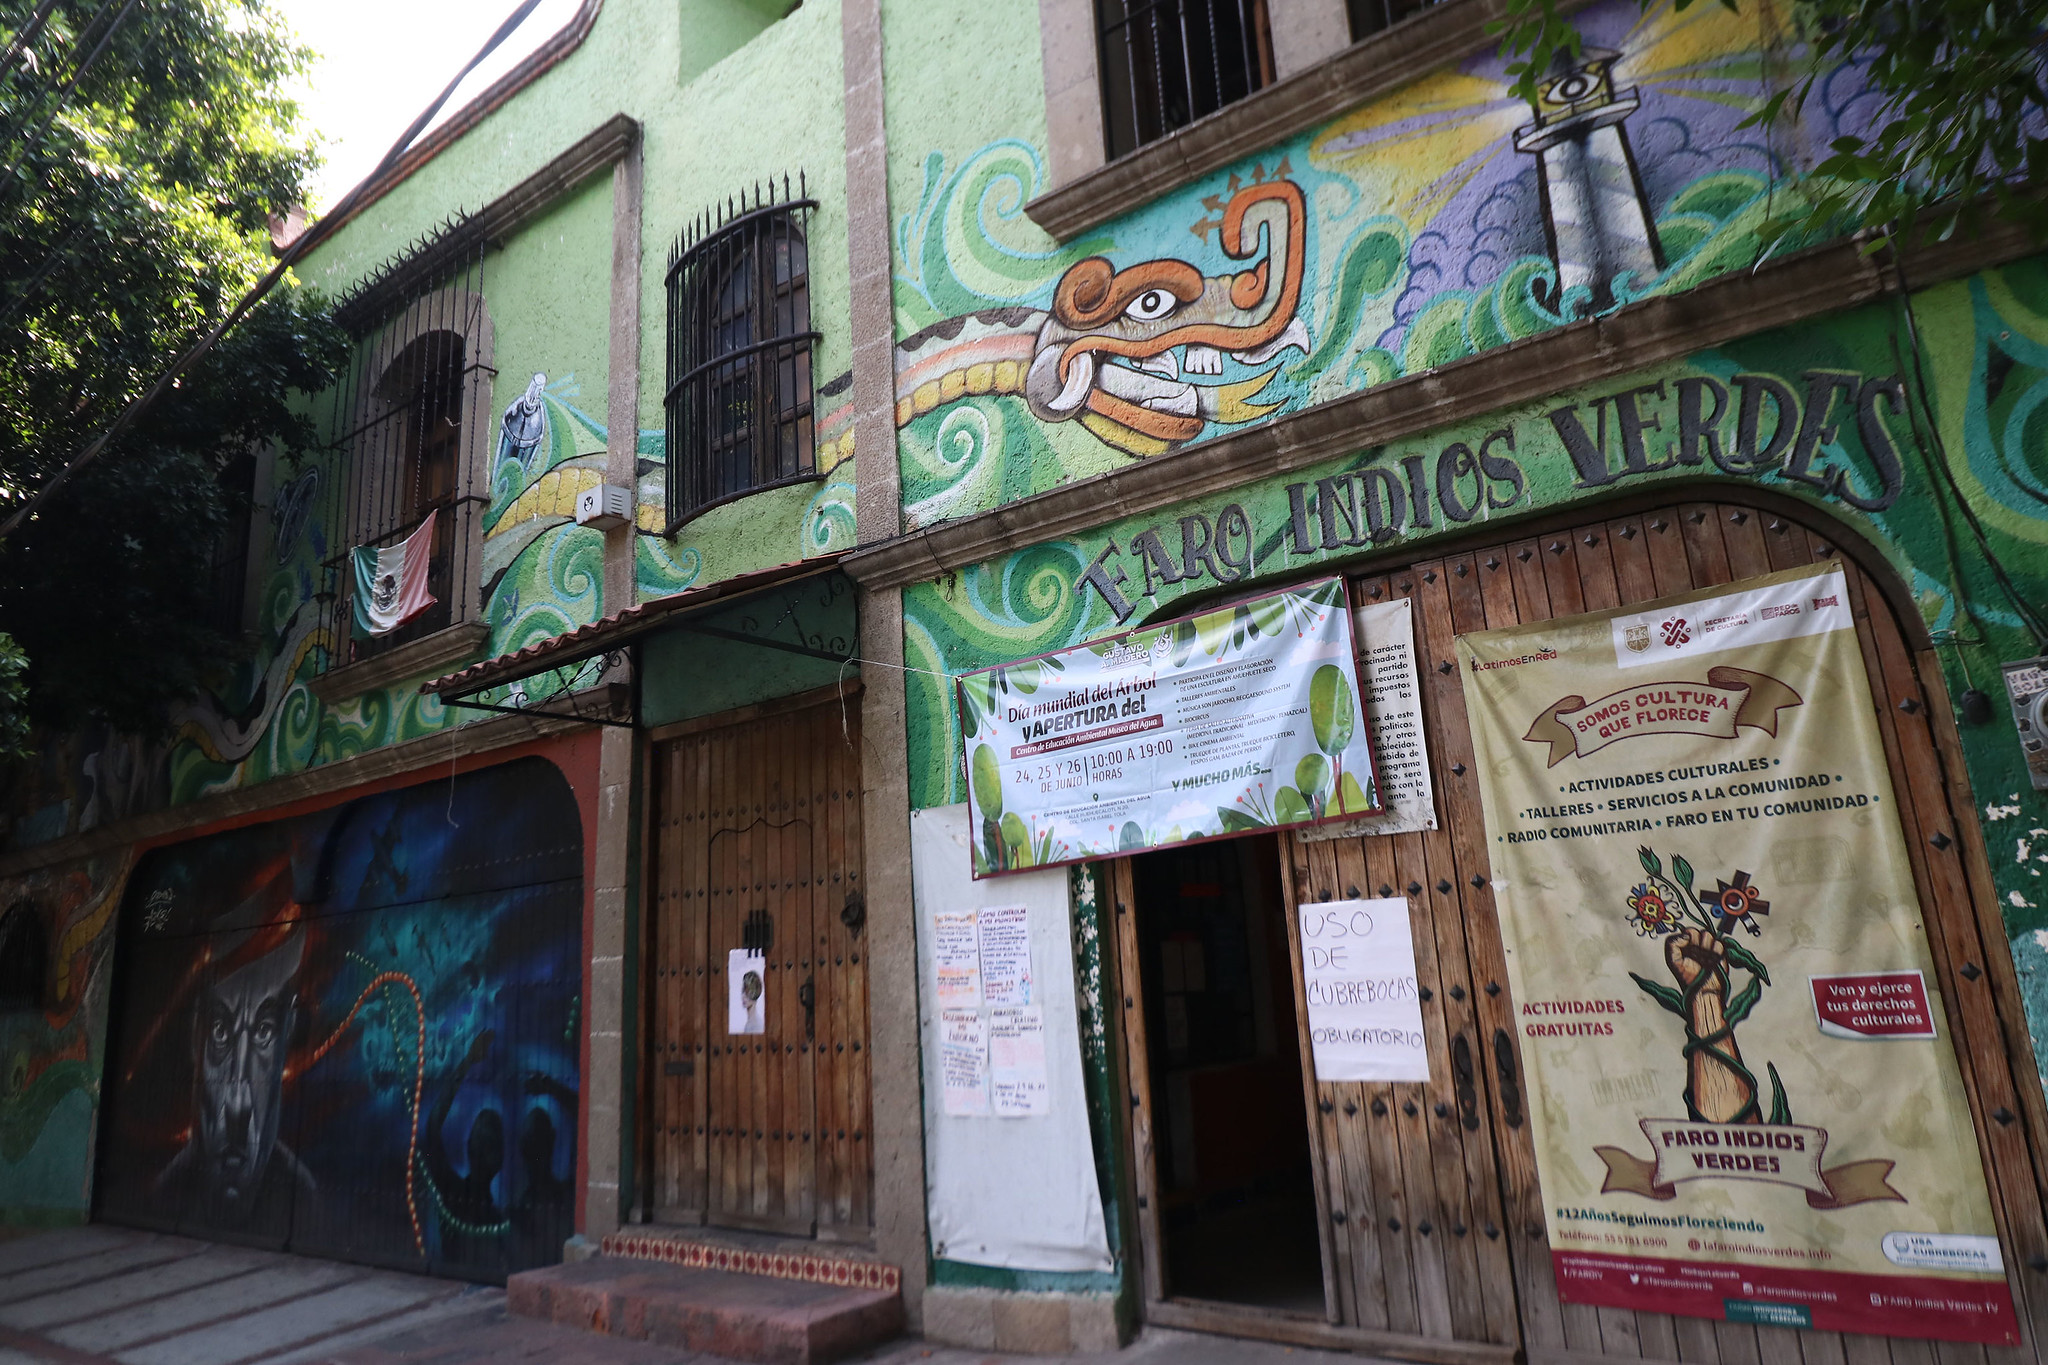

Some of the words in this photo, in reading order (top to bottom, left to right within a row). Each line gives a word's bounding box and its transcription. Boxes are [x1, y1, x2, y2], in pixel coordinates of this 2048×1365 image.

[1074, 503, 1253, 626] FARO
[1284, 427, 1525, 555] INDIOS
[1547, 370, 1905, 513] VERDES
[1704, 612, 1747, 626] SECRETARÍA
[1774, 607, 1800, 617] FAROS
[1716, 619, 1749, 630] CULTURA
[1102, 643, 1144, 660] GUSTAVO
[1372, 643, 1405, 654] carácter
[1111, 650, 1149, 667] MADERO
[1361, 654, 1395, 666] rocinado
[1398, 651, 1407, 659] ni
[1262, 665, 1276, 673] SECO
[1377, 661, 1408, 674] partido
[1375, 672, 1409, 682] recursos
[1369, 682, 1410, 694] impuestos
[1008, 704, 1030, 723] Día
[1033, 687, 1089, 717] mundial
[1091, 681, 1112, 703] del
[1115, 671, 1156, 697] Árbol
[1181, 693, 1203, 702] TALLERES
[1365, 695, 1385, 703] odos
[1032, 702, 1118, 737] APERTURA
[1121, 693, 1146, 717] del
[1397, 711, 1414, 719] este
[1576, 700, 1631, 733] SOMOS
[1635, 690, 1729, 711] CULTURA
[1598, 717, 1632, 739] QUE
[1636, 705, 1711, 725] FLORECE
[1016, 745, 1037, 755] Centro
[1038, 742, 1045, 751] de
[1045, 735, 1074, 749] Educación
[1075, 727, 1107, 742] Ambiental
[1108, 725, 1128, 736] Museo
[1129, 720, 1139, 729] del
[1140, 718, 1157, 729] Agua
[1396, 731, 1417, 739] otros
[1016, 769, 1034, 783] 24,
[1038, 764, 1050, 780] 25
[1055, 762, 1063, 776] Y
[1067, 760, 1081, 774] 26
[1090, 751, 1123, 770] 10:00
[1127, 747, 1135, 761] A
[1138, 739, 1173, 759] 19:00
[1380, 760, 1420, 772] programa
[1040, 781, 1051, 793] DE
[1055, 775, 1082, 790] JUNIO
[1092, 767, 1122, 783] HORAS
[1172, 779, 1180, 792] Y
[1182, 769, 1229, 790] MUCHO
[1231, 760, 1271, 780] MÁS...
[1568, 771, 1664, 794] ACTIVIDADES
[1667, 757, 1769, 781] CULTURALES
[1398, 781, 1413, 789] con
[1415, 779, 1423, 787] la
[1388, 792, 1406, 800] ante
[1416, 789, 1425, 797] la
[1526, 802, 1594, 819] TALLERES
[1607, 791, 1688, 811] SERVICIOS
[1691, 790, 1702, 802] A
[1705, 786, 1726, 800] LA
[1728, 774, 1830, 797] COMUNIDAD
[1507, 829, 1547, 843] RADIO
[1550, 818, 1652, 839] COMUNITARIA
[1666, 812, 1708, 827] FARO
[1712, 810, 1733, 823] EN
[1736, 806, 1759, 820] TU
[1763, 794, 1868, 817] COMUNIDAD
[1304, 911, 1373, 938] USO
[1308, 946, 1349, 970] DE
[1308, 976, 1417, 1006] CUBREBOCAS
[1829, 984, 1856, 996] Ven
[1858, 985, 1866, 998] y
[1869, 982, 1912, 997] ejerce
[1522, 999, 1625, 1016] ACTIVIDADES
[1826, 1000, 1849, 1012] tus
[1851, 998, 1916, 1011] derechos
[1851, 1012, 1923, 1026] culturales
[1312, 1026, 1422, 1048] OBLIGATORIO
[1526, 1022, 1615, 1037] GRATUITAS
[1661, 1130, 1719, 1149] FARO
[1724, 1129, 1805, 1152] INDIOS
[1692, 1152, 1781, 1174] VERDES
[1556, 1208, 1765, 1233] #12AñosSeguimosFloreciendo
[1559, 1230, 1602, 1242] Teléfono:
[1910, 1237, 1932, 1246] USA
[1913, 1248, 1987, 1259] CUBREBOCAS
